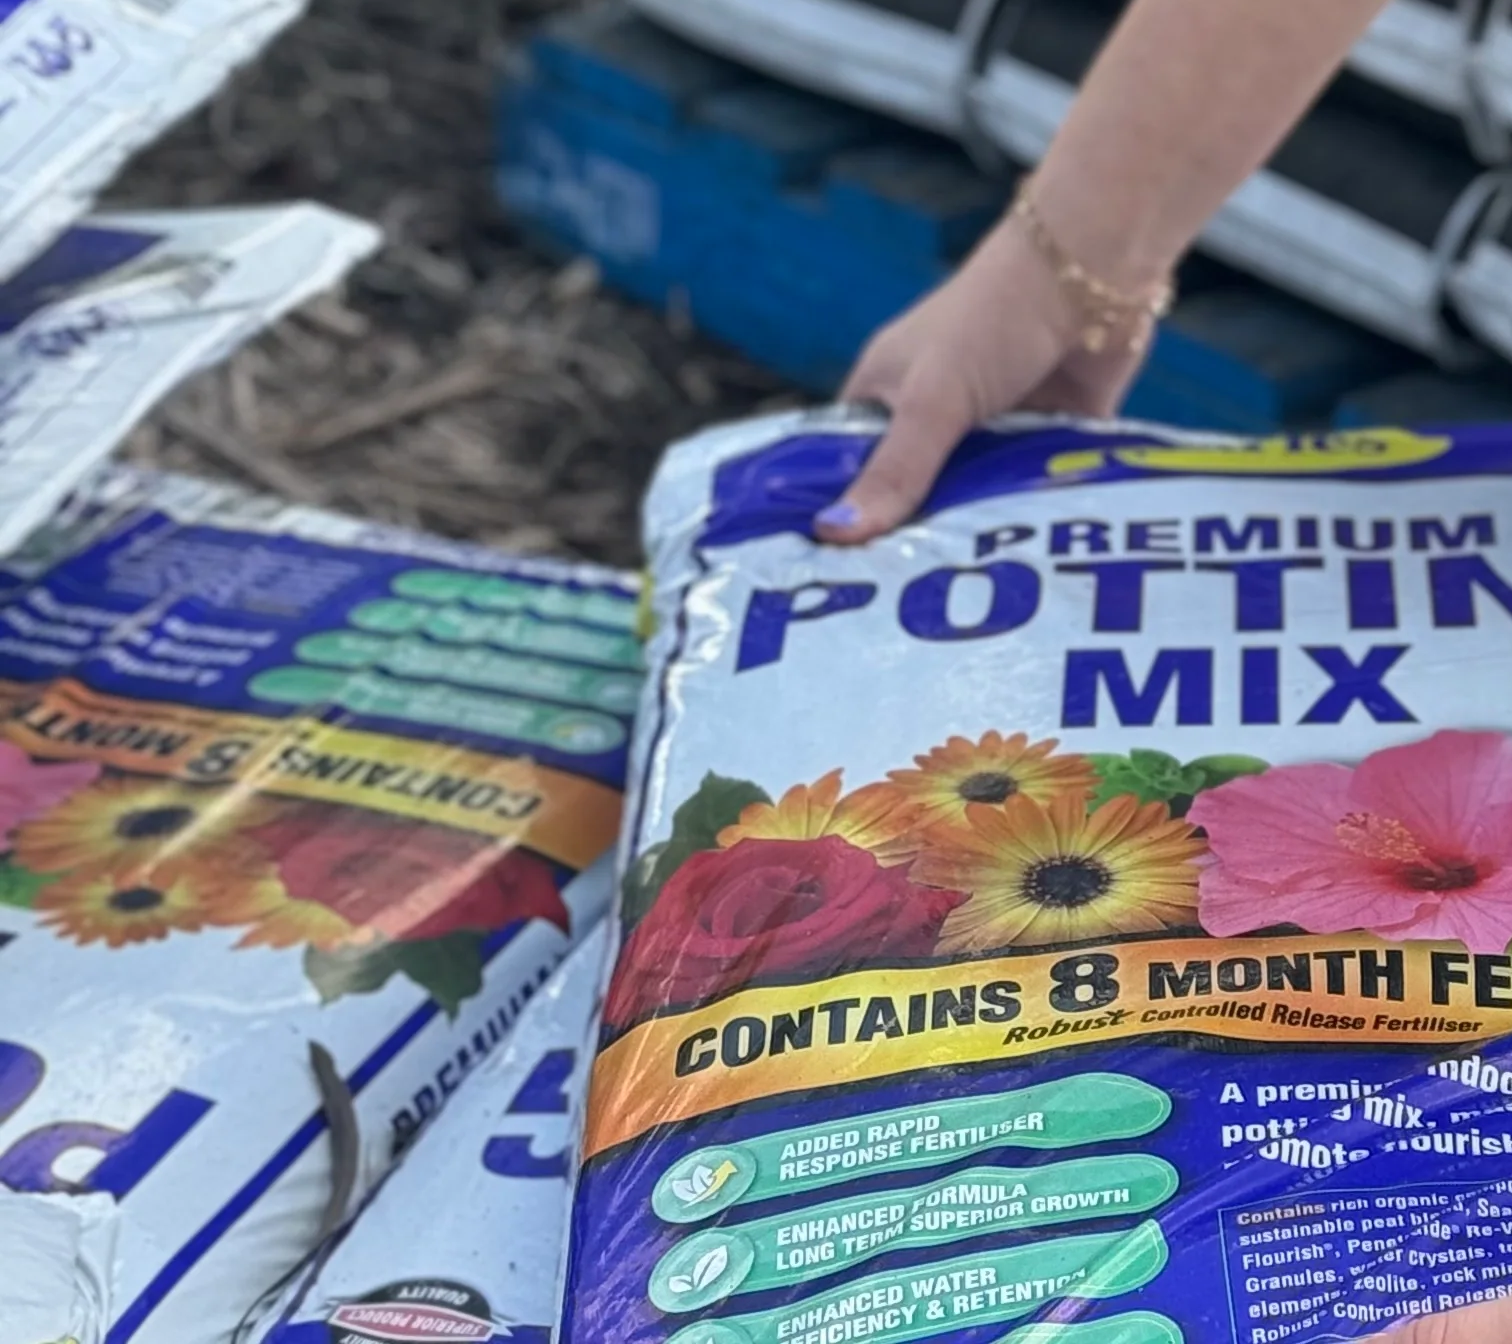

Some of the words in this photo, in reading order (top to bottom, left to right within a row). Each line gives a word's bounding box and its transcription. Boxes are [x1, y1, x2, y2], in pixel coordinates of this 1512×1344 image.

[973, 514, 1500, 564] PREMIUM
[1059, 645, 1419, 729] MIX
[271, 745, 543, 822] CONTAINS
[674, 980, 1022, 1079] CONTAINS
[1048, 953, 1120, 1015] 8
[1147, 949, 1397, 1002] MONTH
[1001, 1009, 1138, 1047] Robust
[1139, 999, 1266, 1025] Controlled
[1270, 1002, 1366, 1031] Release
[1371, 1014, 1483, 1034] Fertiliser
[1219, 1082, 1245, 1104] A
[1255, 1079, 1402, 1107] premiu
[779, 1128, 862, 1161] ADDED
[865, 1114, 940, 1144] RAPID
[1221, 1102, 1352, 1148] pott
[1362, 1093, 1437, 1130] mix,
[778, 1144, 904, 1181] RESPONSE
[909, 1112, 1045, 1155] FERTILISER
[1223, 1137, 1371, 1169] omote
[775, 1242, 837, 1272] LONG
[842, 1218, 906, 1257] TERM
[909, 1199, 1026, 1234] SUPERIOR
[1029, 1185, 1131, 1215] GROWTH
[776, 1204, 905, 1247] ENHANCED
[911, 1183, 1029, 1213] FORMULA
[1237, 1203, 1326, 1226] Contains
[1375, 1193, 1450, 1211] organic
[1238, 1218, 1355, 1247] sustainable
[1361, 1214, 1406, 1234] peat
[397, 1286, 471, 1307] QUALITY
[1432, 1266, 1477, 1286] rock
[346, 1307, 413, 1327] PRODUCT
[413, 1315, 482, 1336] SUPERIOR
[776, 1285, 904, 1340] ENHANCED
[910, 1267, 997, 1299] WATER
[924, 1298, 947, 1320] &
[1332, 1294, 1434, 1322] Controlled
